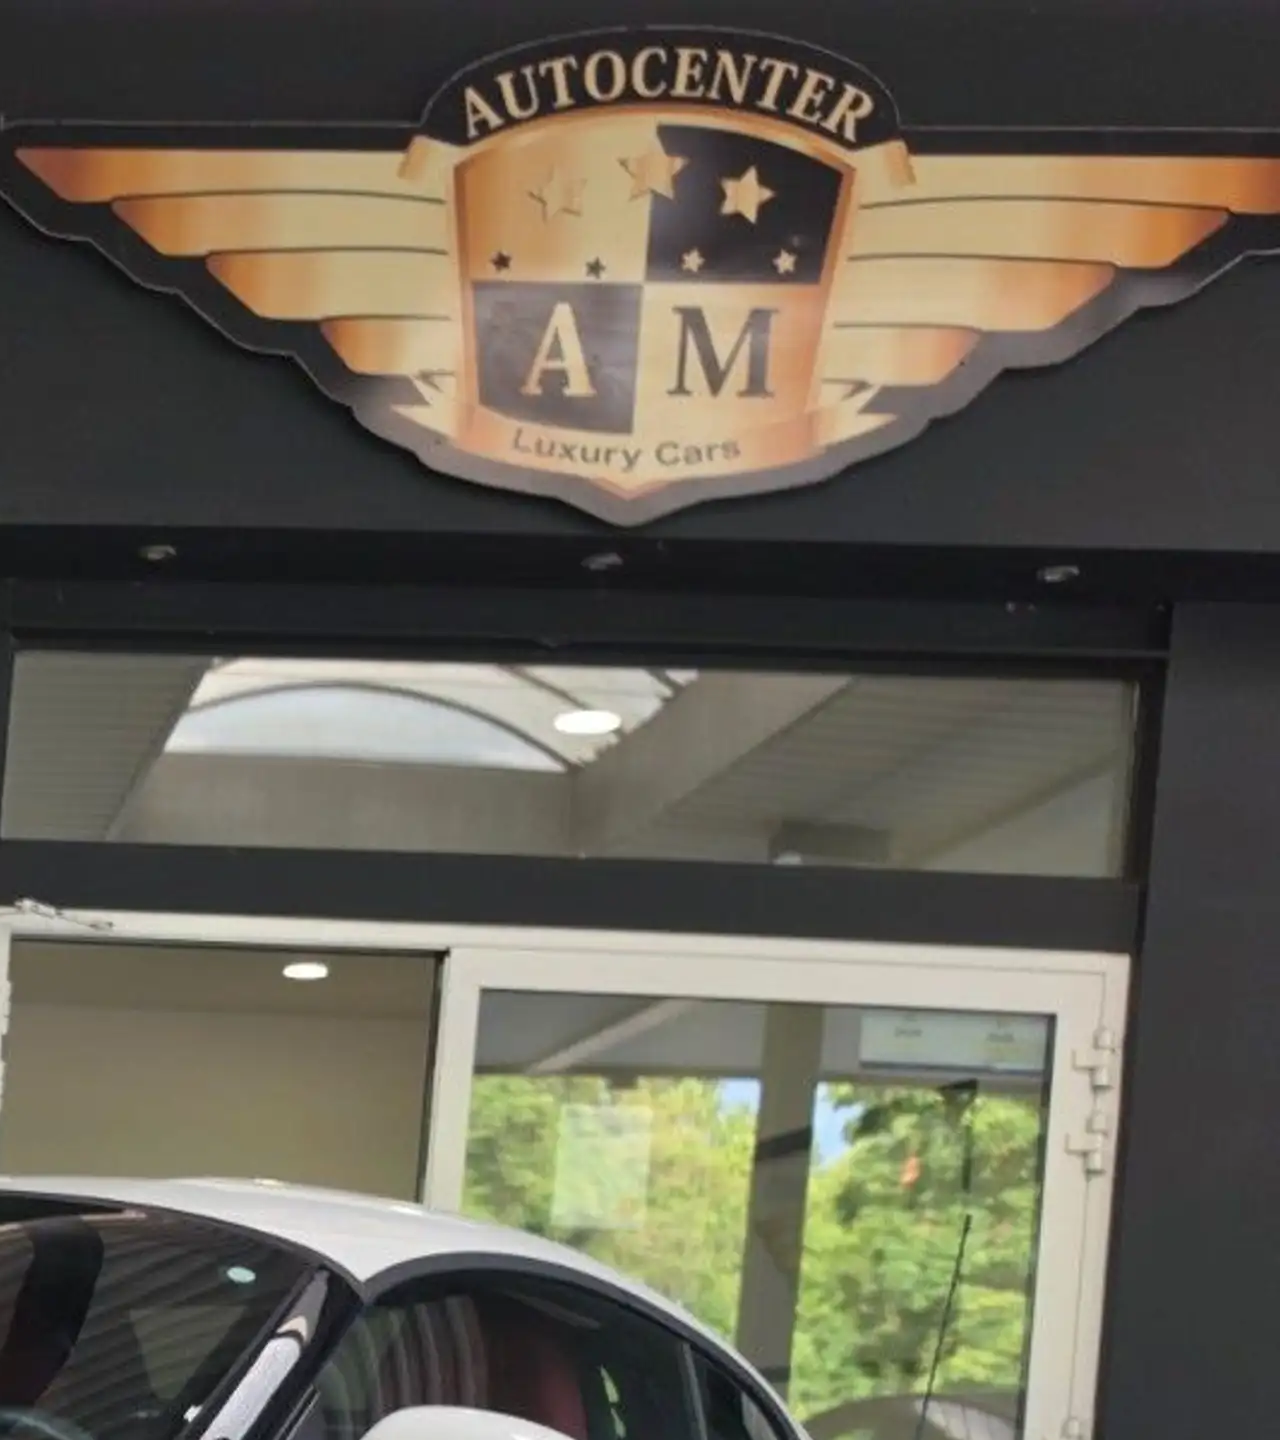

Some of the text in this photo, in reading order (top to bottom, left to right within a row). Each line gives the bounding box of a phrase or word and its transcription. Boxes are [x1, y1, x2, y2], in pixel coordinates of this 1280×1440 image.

[463, 47, 875, 143] AUTOCENTER
[520, 301, 780, 398] A M
[511, 428, 742, 473] Luxury Cars
